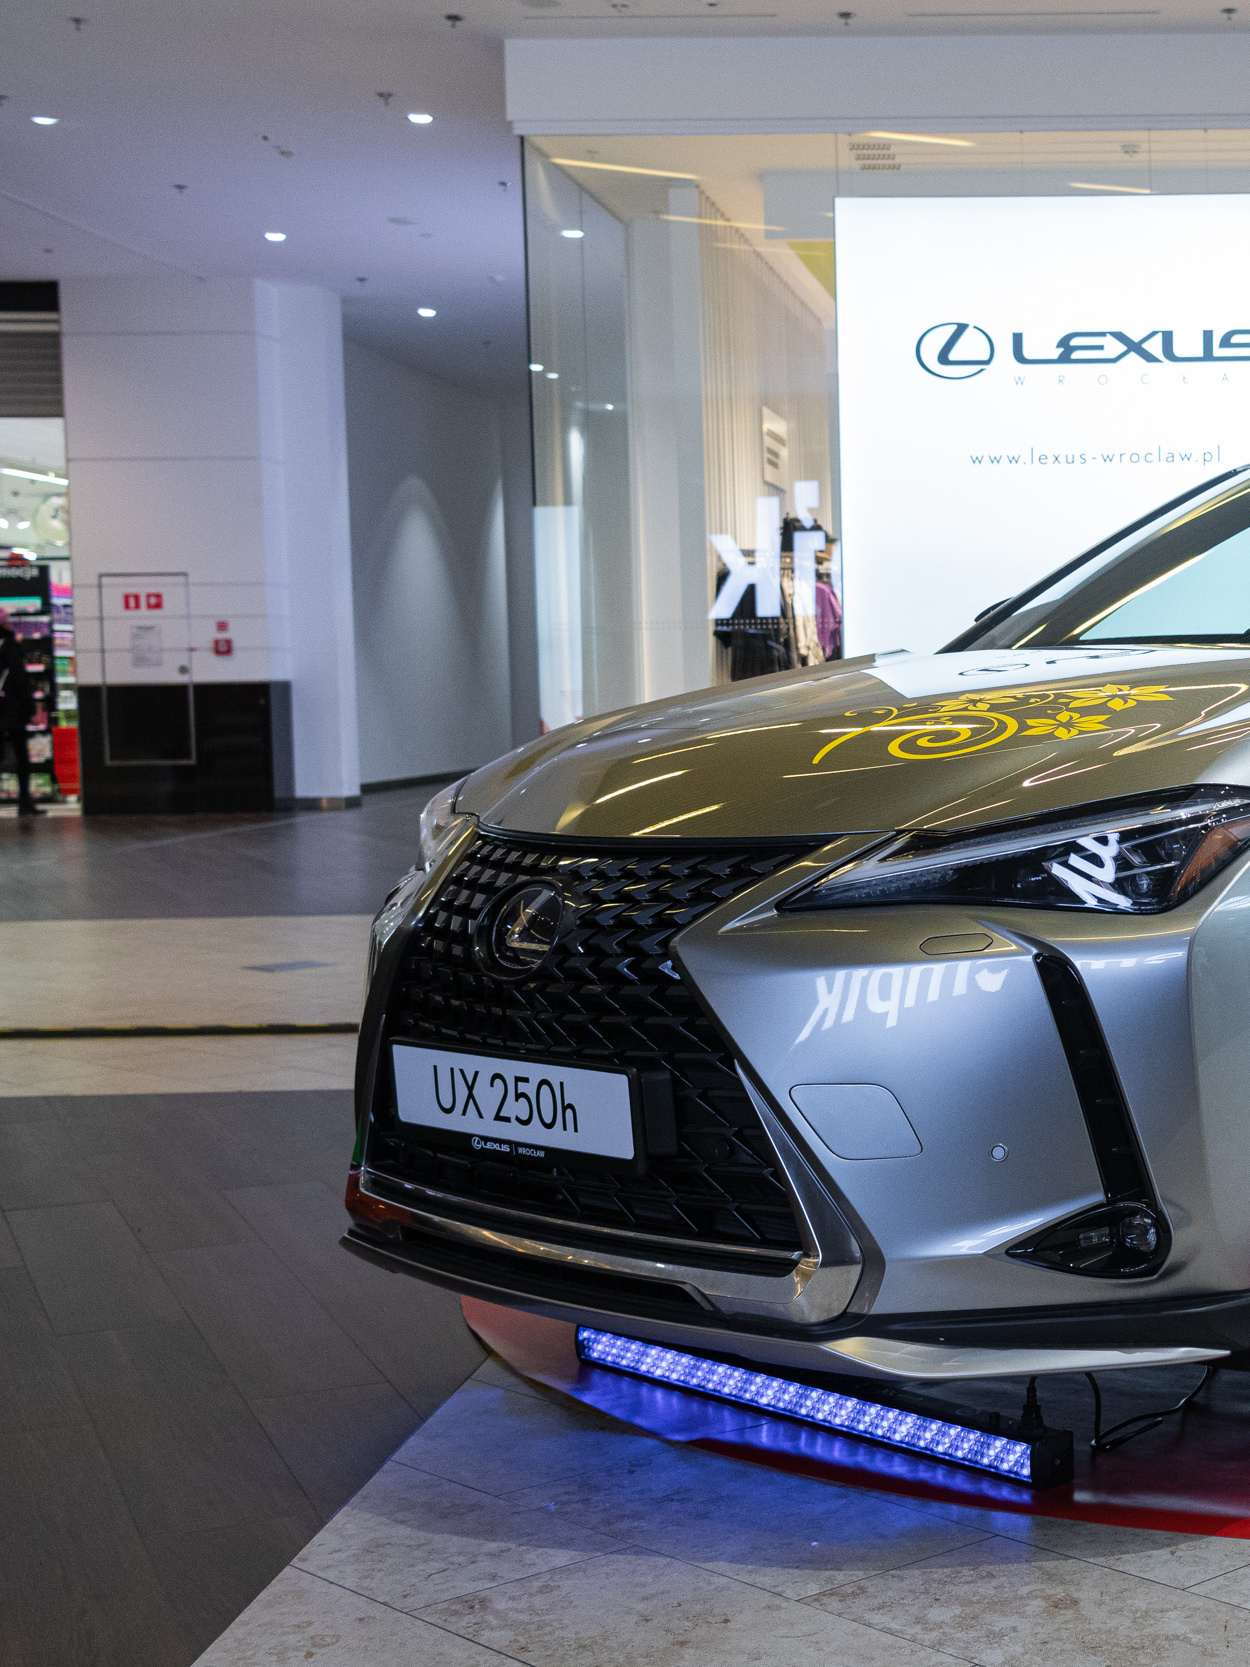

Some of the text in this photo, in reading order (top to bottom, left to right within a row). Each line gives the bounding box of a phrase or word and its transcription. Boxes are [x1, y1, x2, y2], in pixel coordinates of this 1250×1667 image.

[970, 445, 1221, 466] www.lexus-wroclaw.pl
[433, 1064, 579, 1133] UX 250h
[482, 1140, 510, 1152] LEXUS
